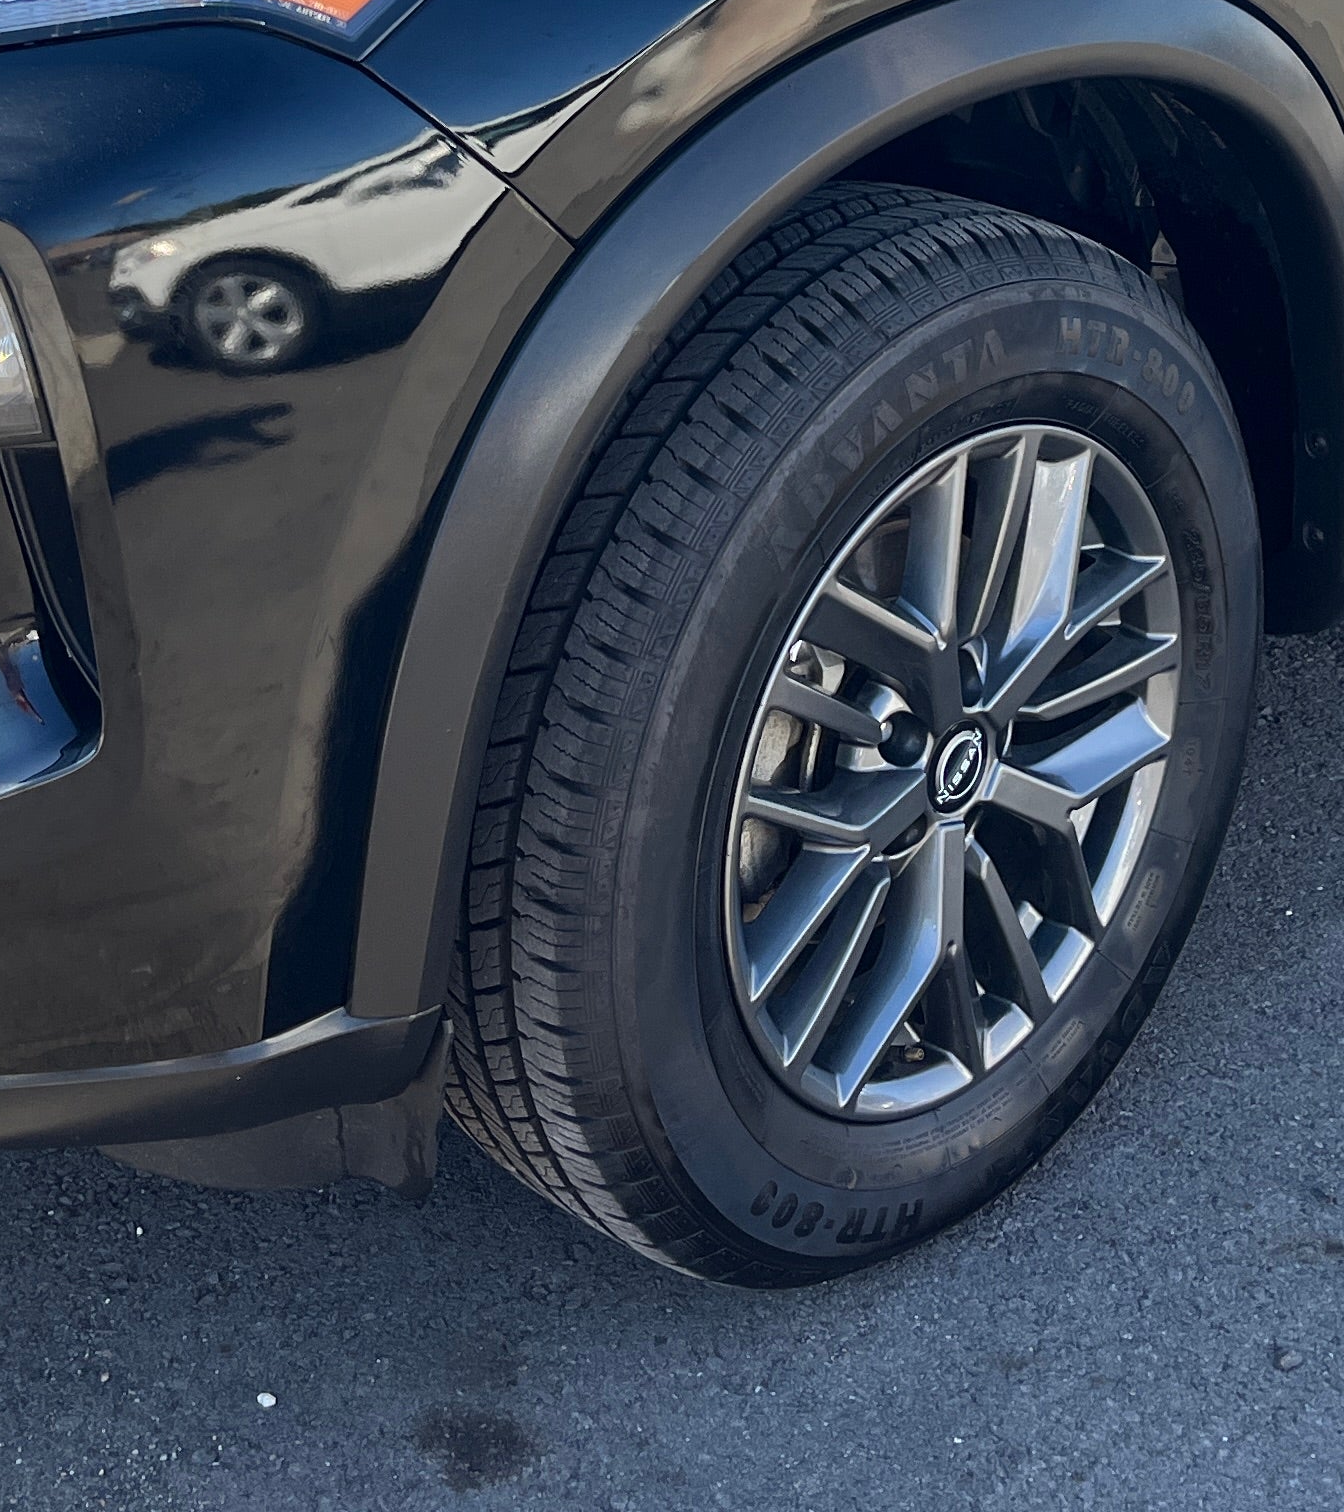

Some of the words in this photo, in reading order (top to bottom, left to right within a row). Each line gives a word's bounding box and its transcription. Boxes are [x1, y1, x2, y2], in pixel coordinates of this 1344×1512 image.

[770, 328, 1008, 571] ADVANTA
[1056, 316, 1197, 415] HTR-800
[936, 727, 983, 805] NISSAN
